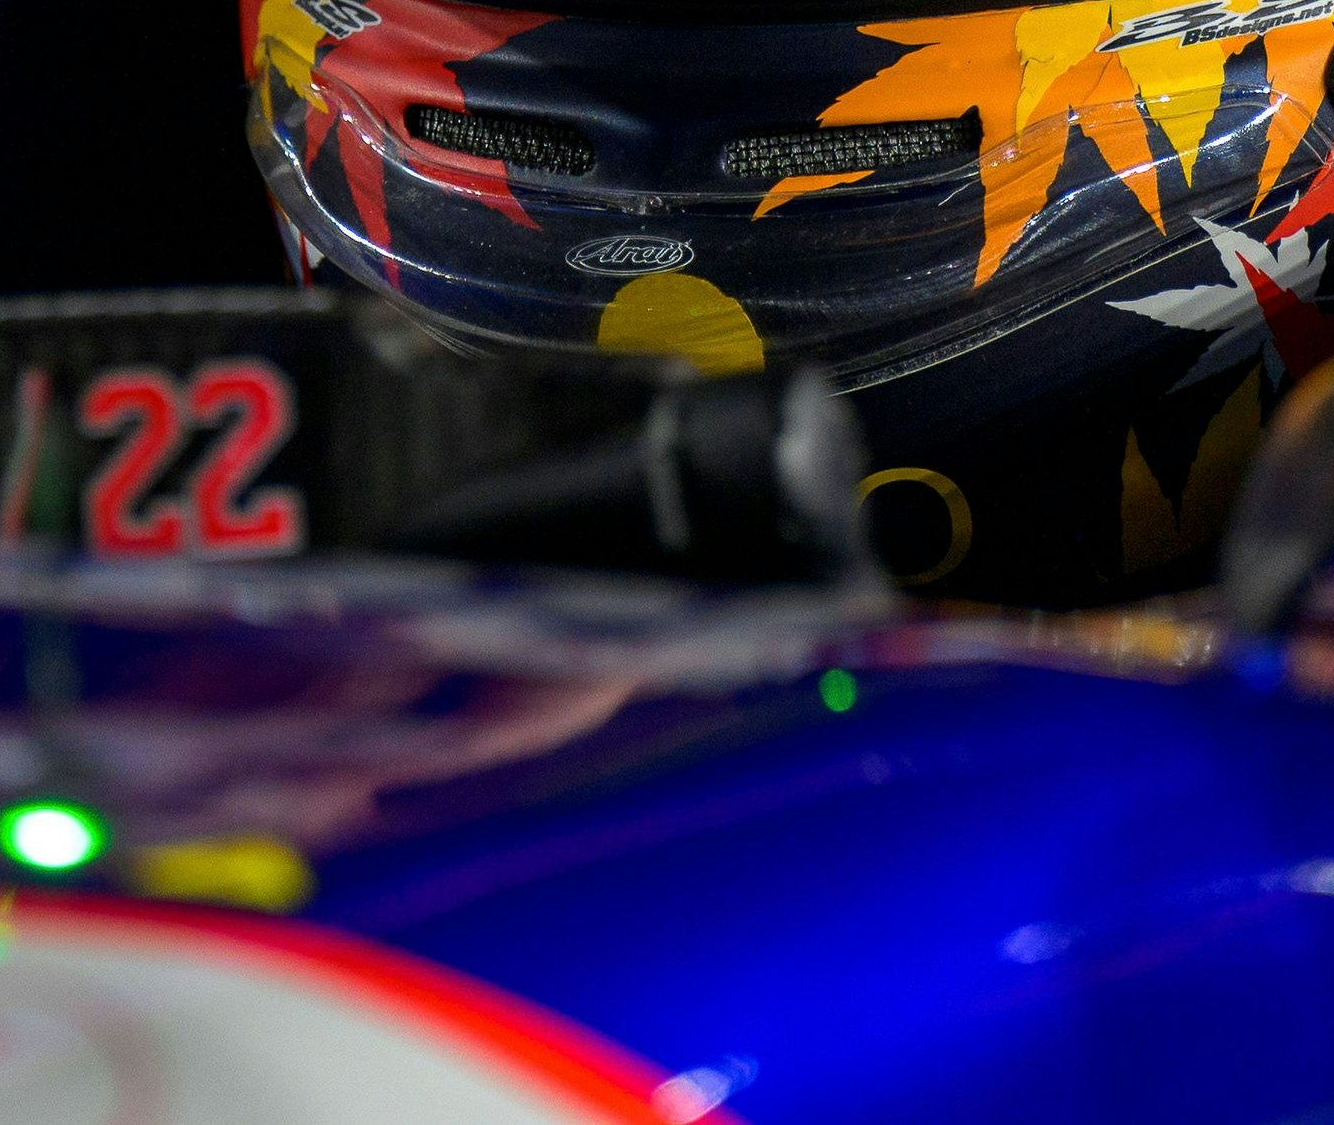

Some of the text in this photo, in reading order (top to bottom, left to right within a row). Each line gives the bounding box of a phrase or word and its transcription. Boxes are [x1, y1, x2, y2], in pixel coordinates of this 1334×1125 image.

[1181, 0, 1334, 47] BSdesigns.net
[571, 237, 680, 266] Arai
[79, 360, 302, 557] 22
